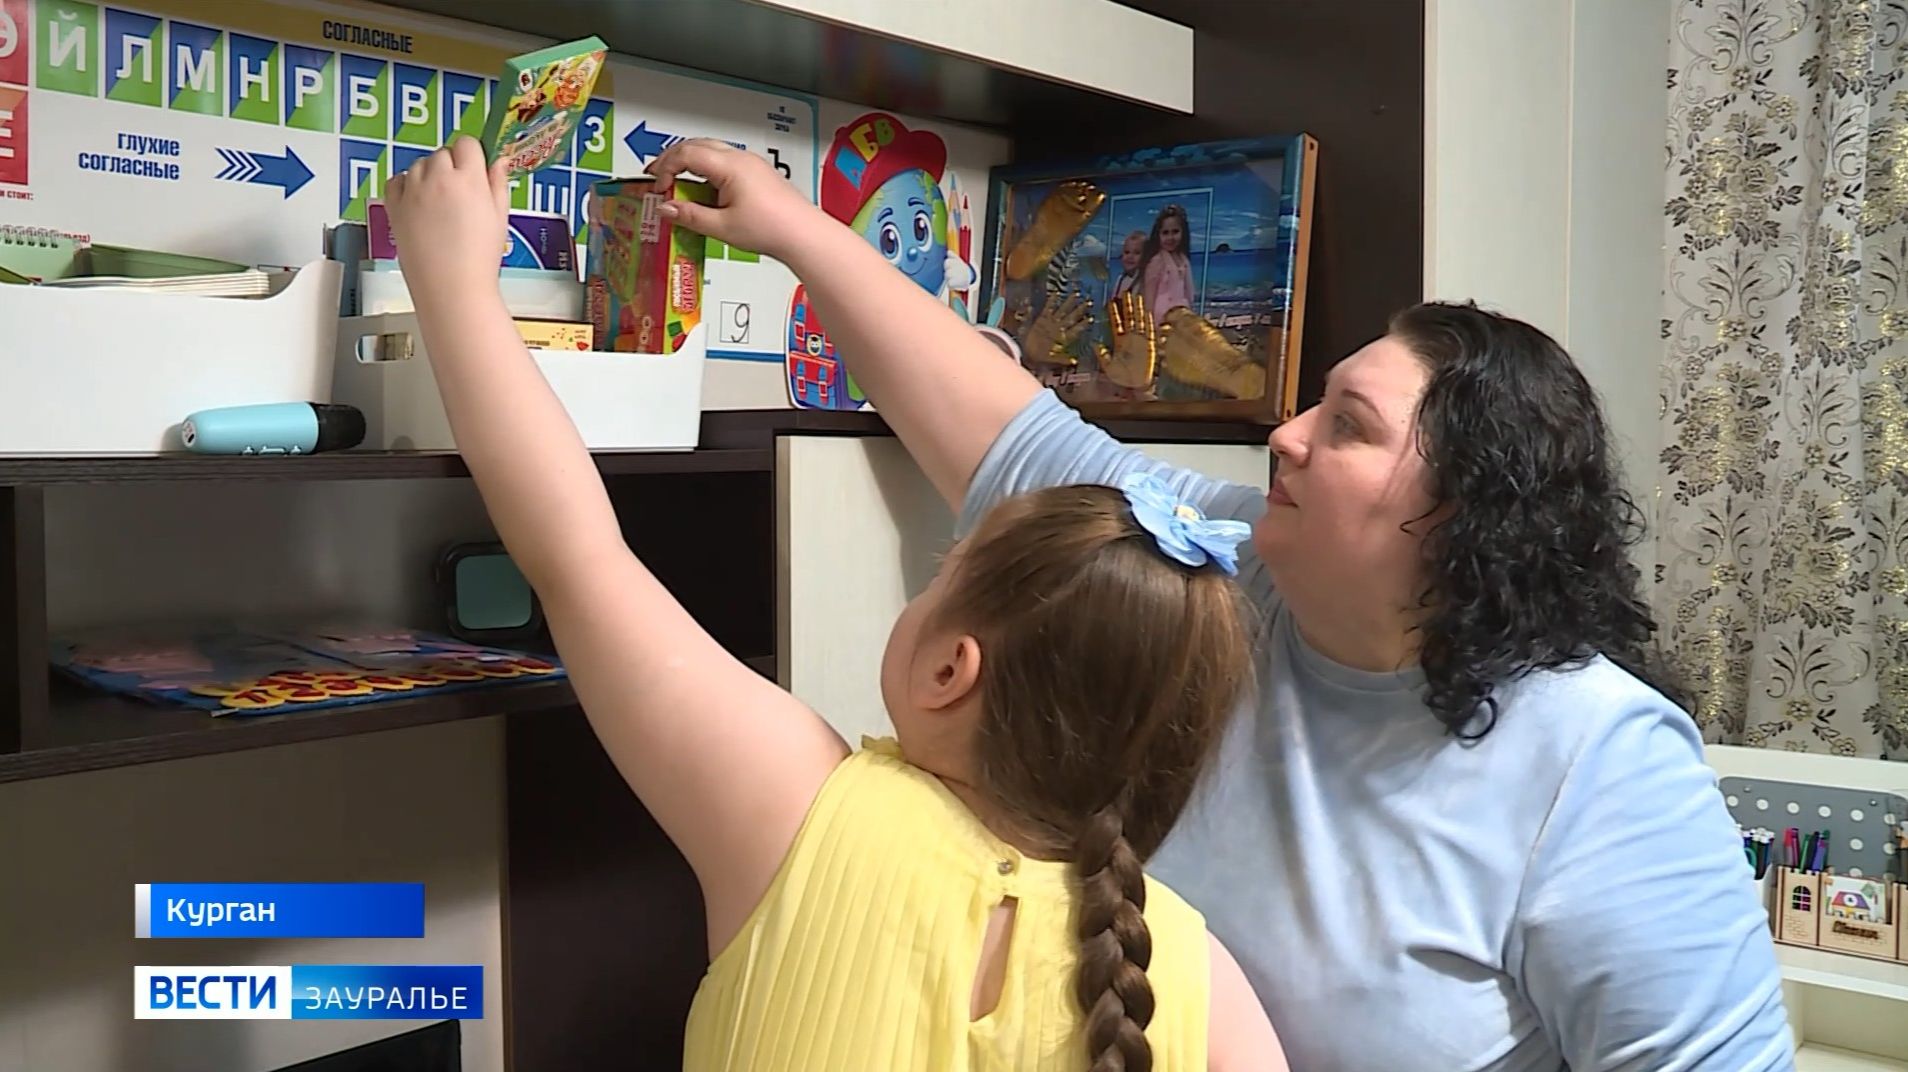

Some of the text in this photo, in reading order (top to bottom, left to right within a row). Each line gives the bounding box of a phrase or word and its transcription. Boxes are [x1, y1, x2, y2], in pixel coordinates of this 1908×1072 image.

[323, 20, 412, 53] СОГЛАСНЫЕ
[49, 10, 87, 72] Й
[116, 33, 152, 83] Л
[176, 45, 216, 94] М
[239, 57, 269, 102] Н
[295, 66, 324, 107] Р
[349, 76, 379, 118] Б
[402, 84, 429, 124] В
[453, 93, 475, 130] Г
[585, 116, 605, 153] З
[117, 132, 179, 156] глухие
[835, 118, 895, 191] АБВ
[79, 153, 179, 180] согласные
